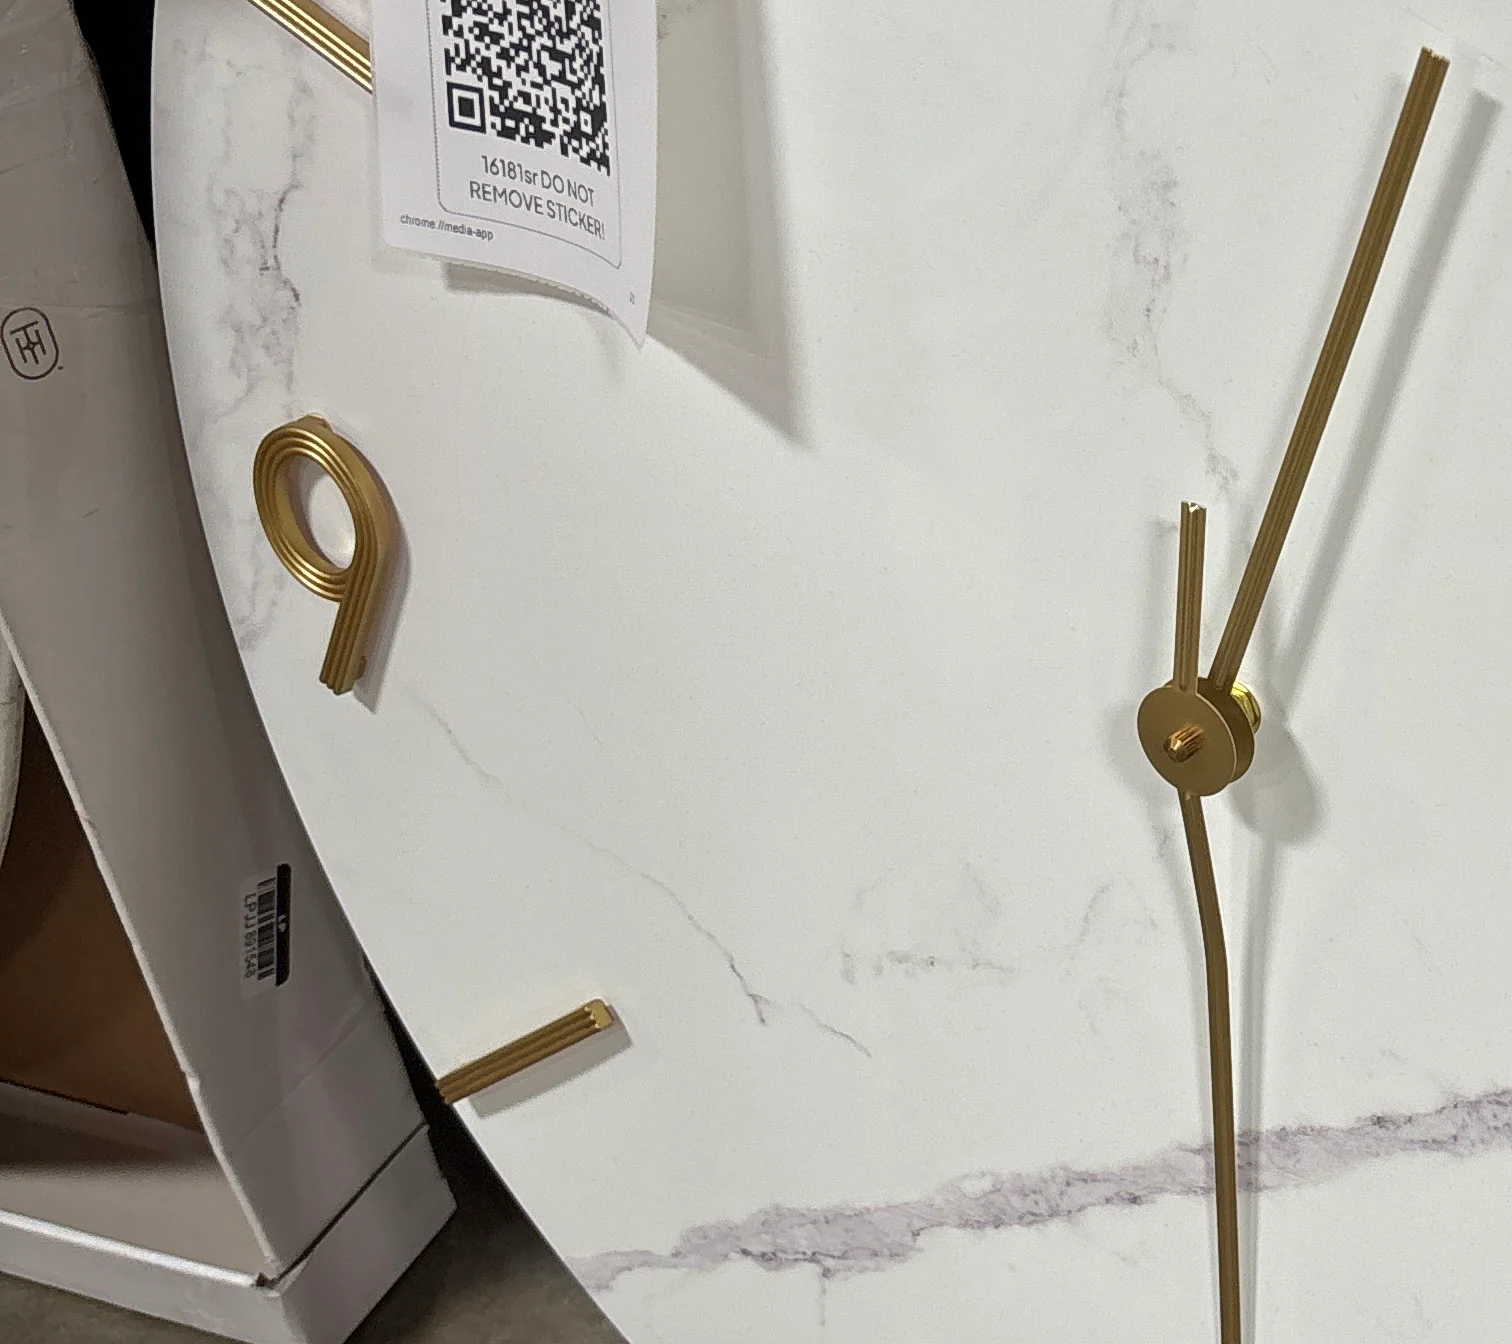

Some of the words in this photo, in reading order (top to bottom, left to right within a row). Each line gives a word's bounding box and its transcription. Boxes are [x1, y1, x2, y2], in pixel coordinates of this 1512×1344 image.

[470, 180, 542, 215] REMOVE
[547, 200, 605, 240] STICKER!
[482, 154, 538, 186] 16181sr
[541, 171, 564, 193] DO
[568, 181, 594, 207] NOT
[253, 413, 389, 695] 9
